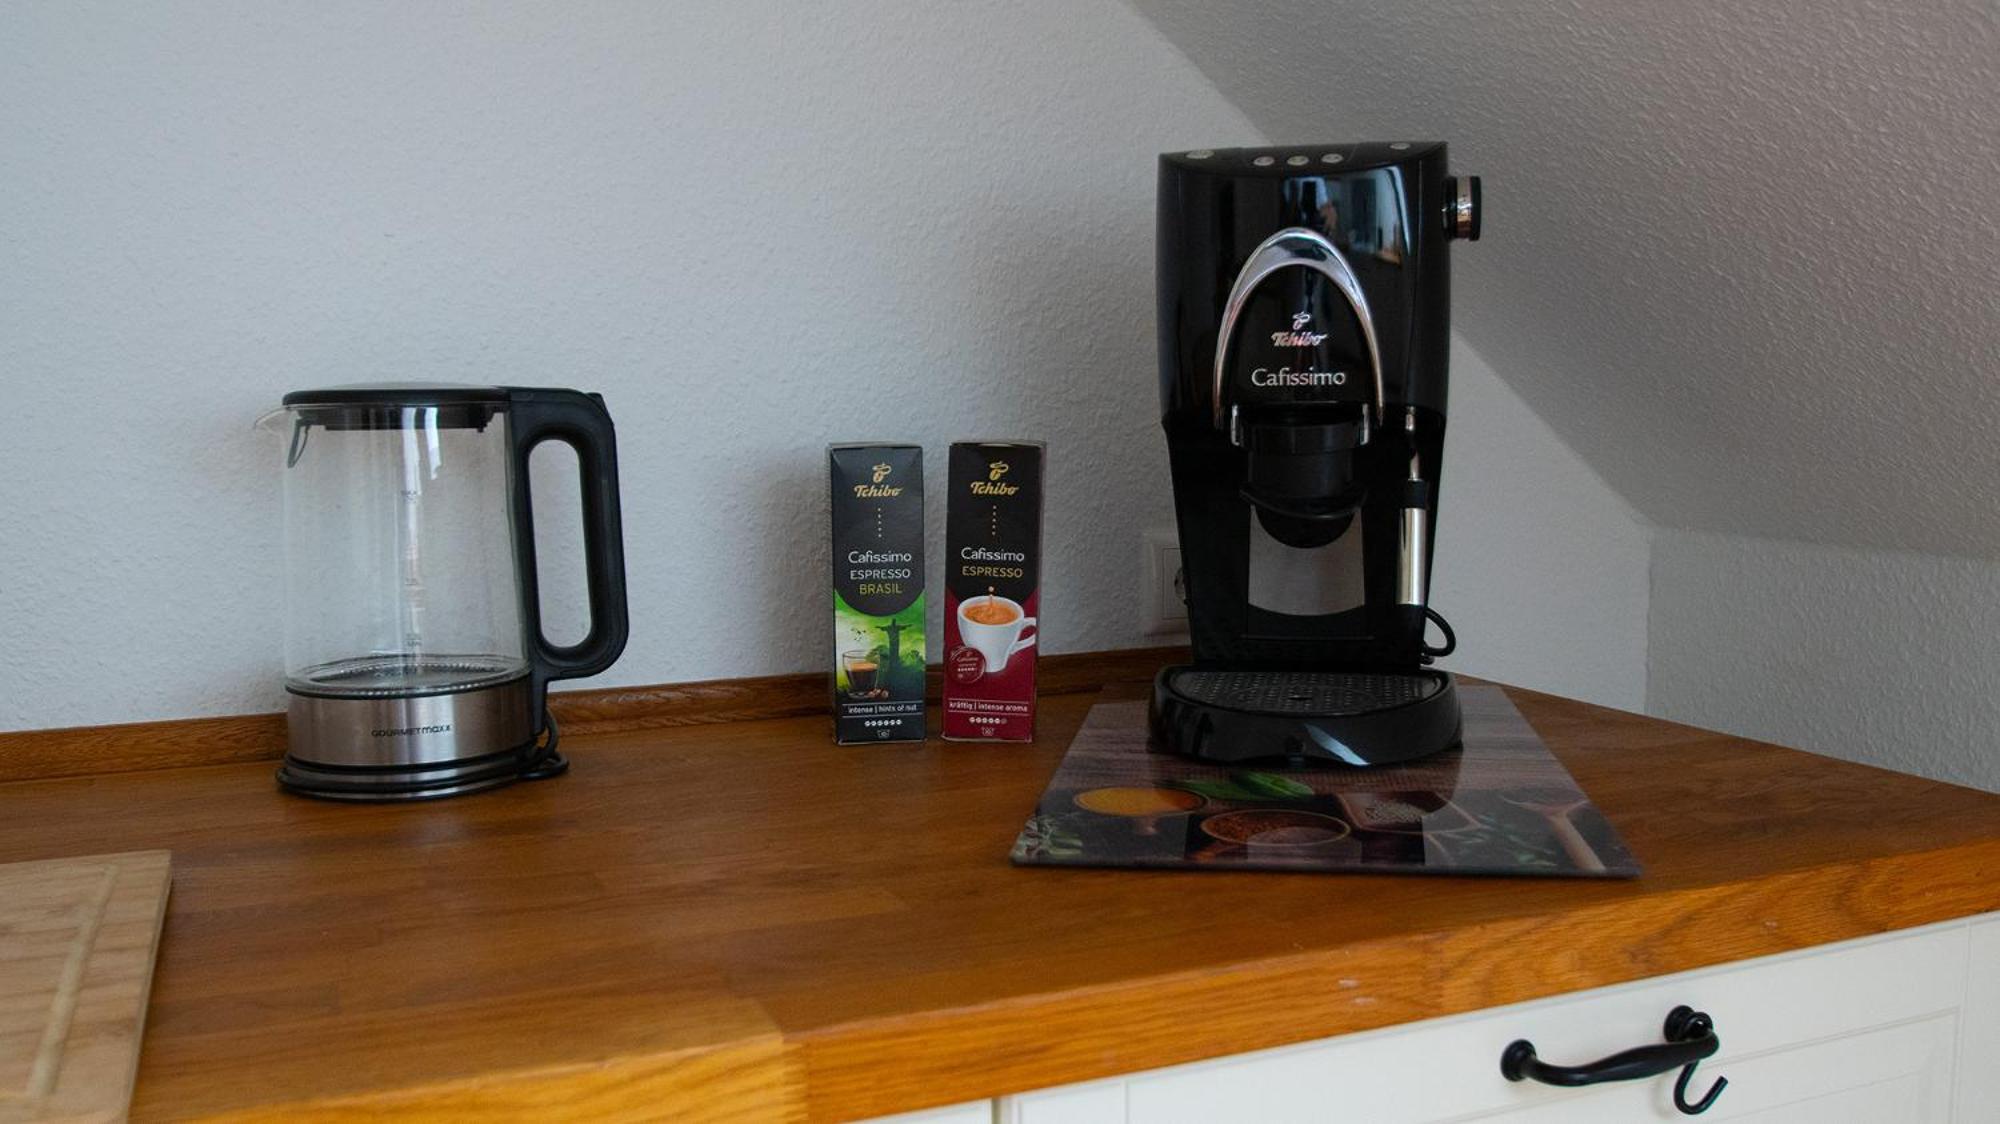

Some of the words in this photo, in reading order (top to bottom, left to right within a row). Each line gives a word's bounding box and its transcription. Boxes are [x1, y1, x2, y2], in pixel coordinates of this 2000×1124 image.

[1271, 331, 1328, 346] Tchibo
[1251, 366, 1346, 388] Cafissimo
[854, 485, 903, 498] Tchibo
[970, 481, 1019, 496] Tchibo
[848, 550, 912, 564] Cafissimo
[961, 547, 1025, 562] Cafissimo
[850, 568, 911, 580] ESPRESSO
[962, 566, 1024, 579] ESPRESSO
[859, 583, 904, 596] BRASIL
[848, 706, 873, 714] intense
[978, 702, 1004, 711] intense
[1005, 704, 1028, 712] aroma
